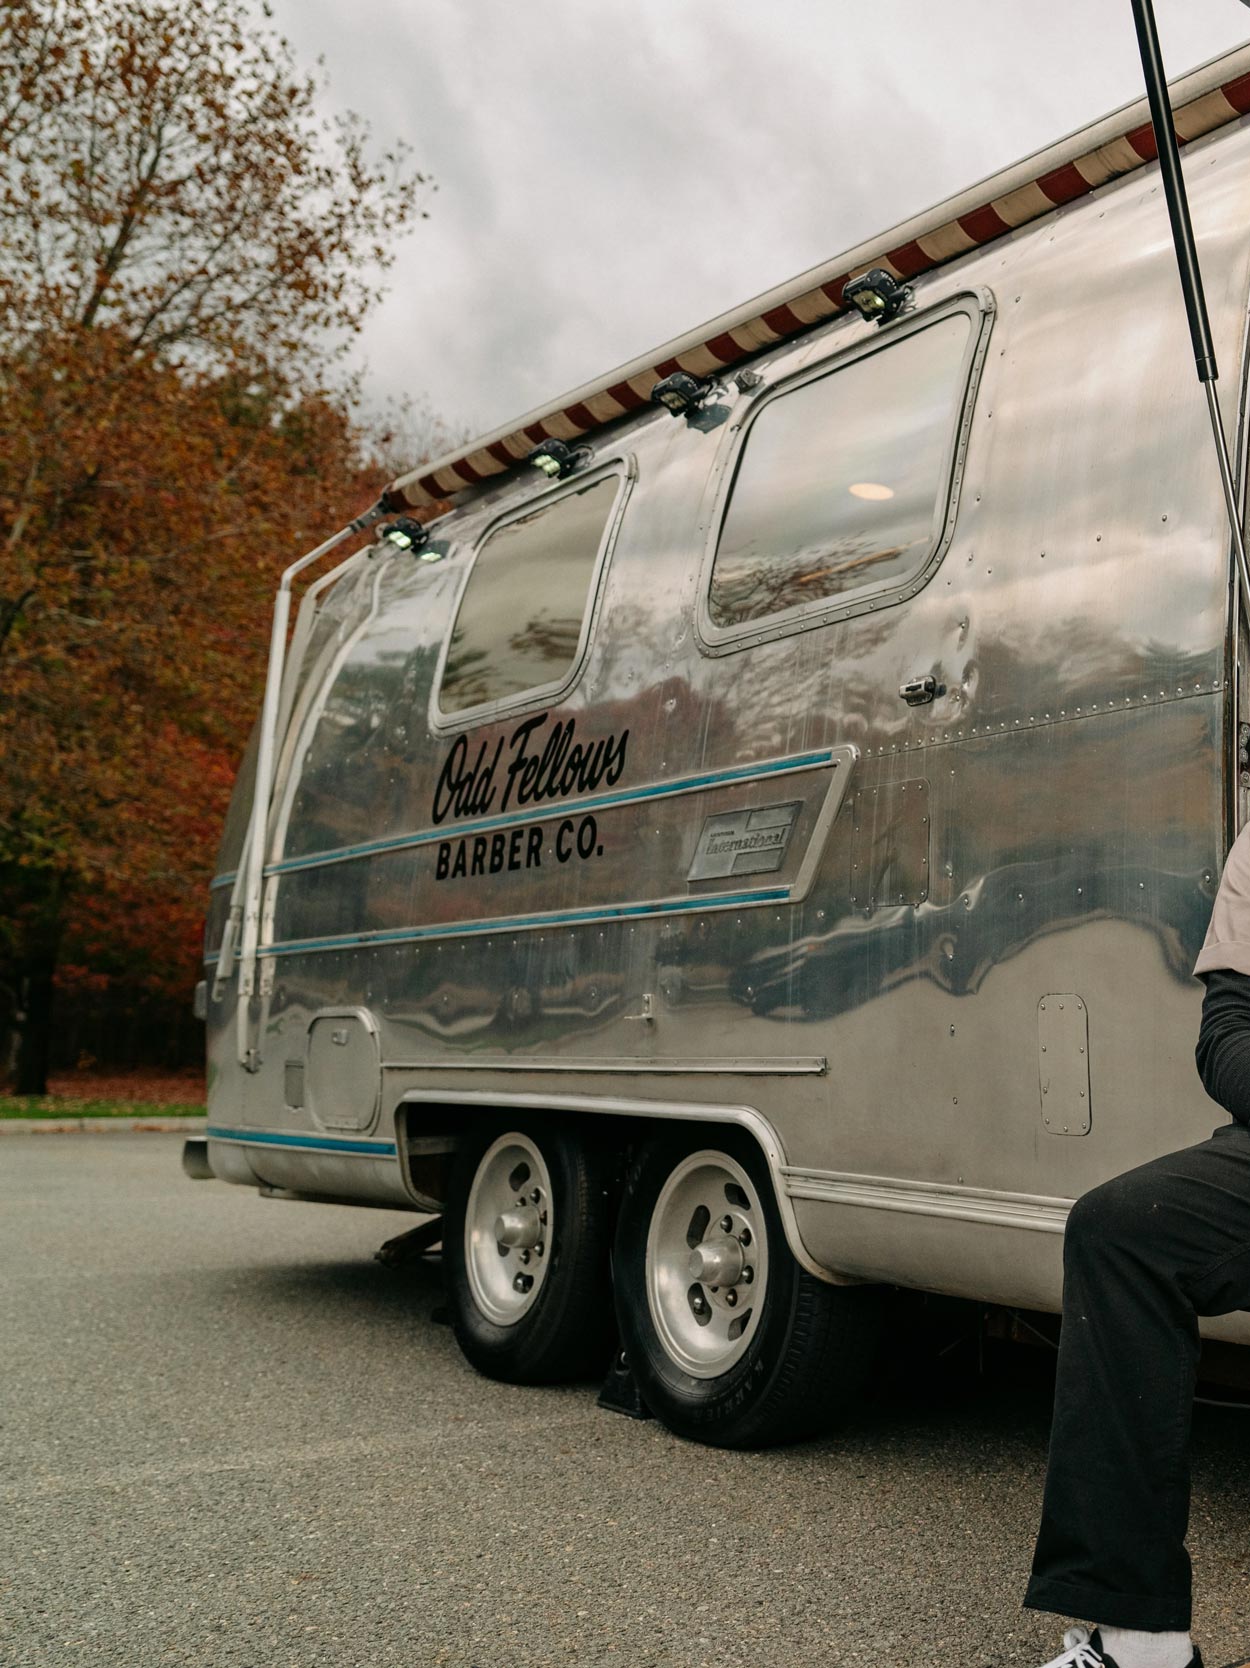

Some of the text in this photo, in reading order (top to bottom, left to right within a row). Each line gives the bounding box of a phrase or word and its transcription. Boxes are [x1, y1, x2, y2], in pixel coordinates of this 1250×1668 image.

[432, 711, 630, 825] Odd Fellows
[435, 815, 604, 881] BARBER CO.
[706, 827, 786, 855] International
